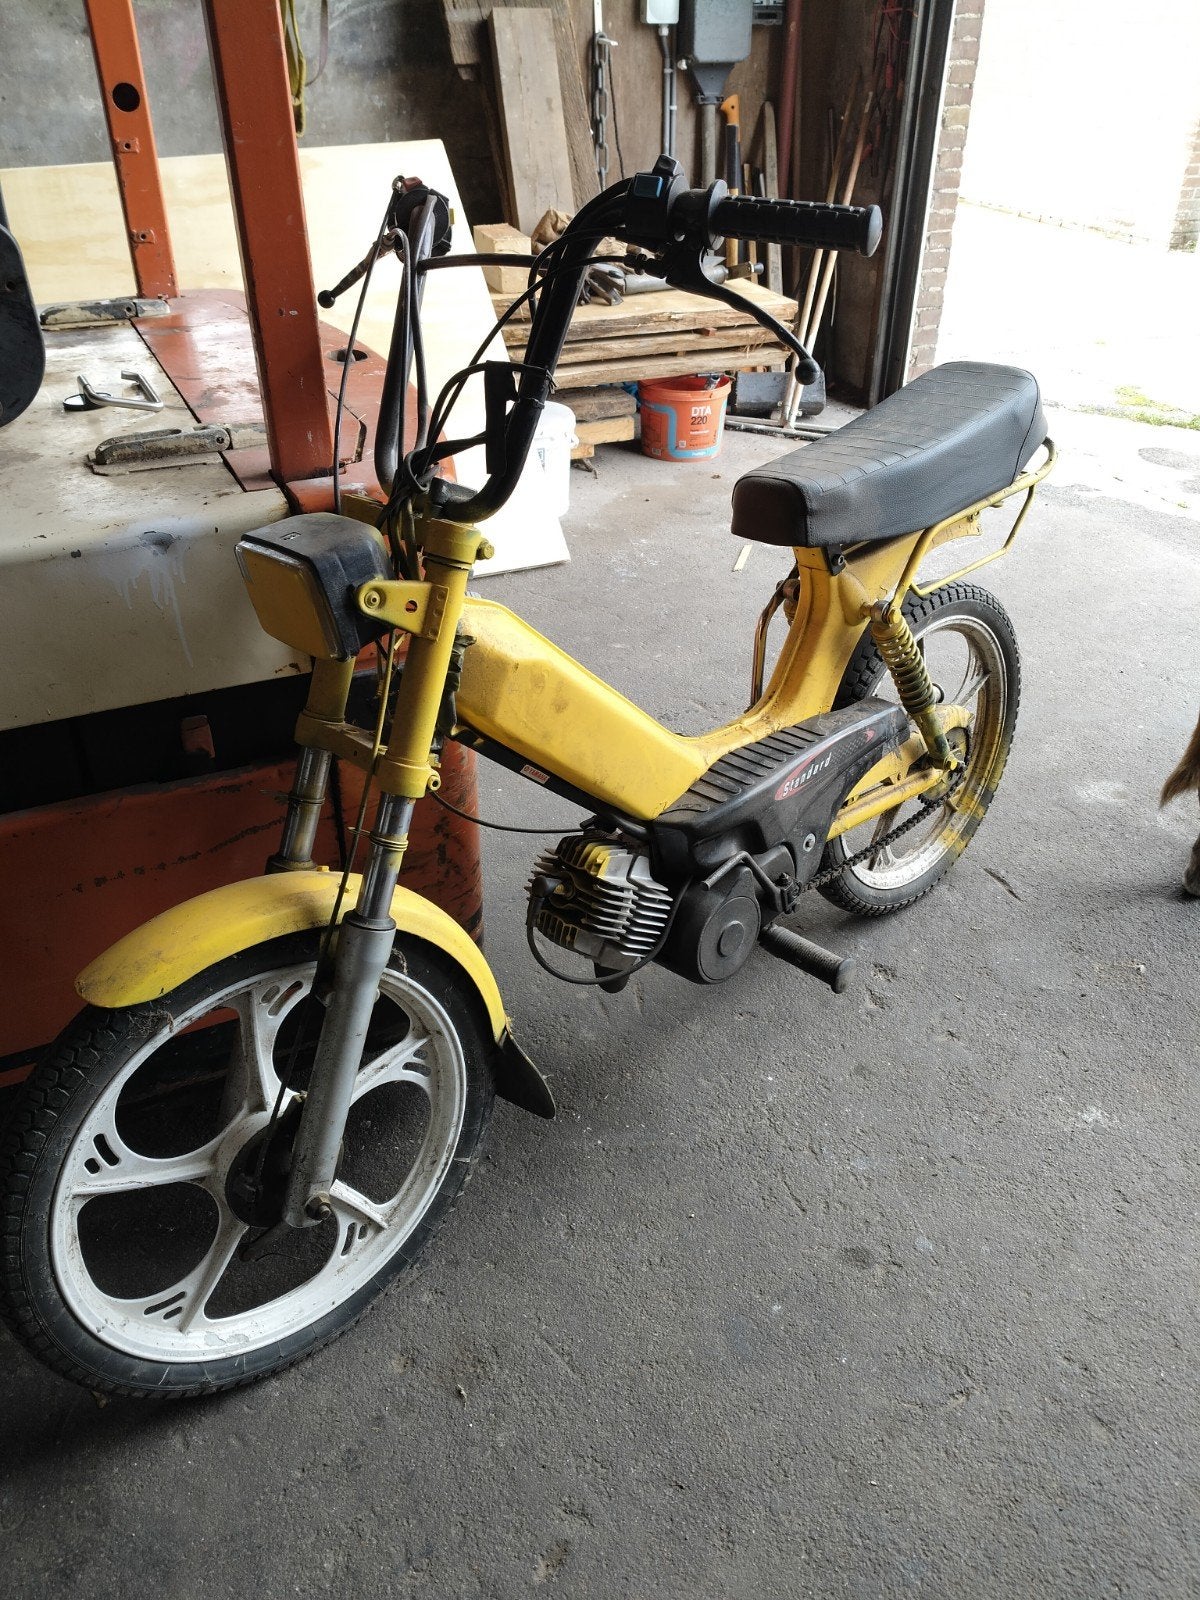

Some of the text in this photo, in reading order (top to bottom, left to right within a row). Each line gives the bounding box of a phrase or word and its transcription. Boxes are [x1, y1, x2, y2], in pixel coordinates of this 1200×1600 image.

[691, 405, 712, 416] DTA
[690, 416, 707, 425] 220
[782, 752, 832, 797] Standard
